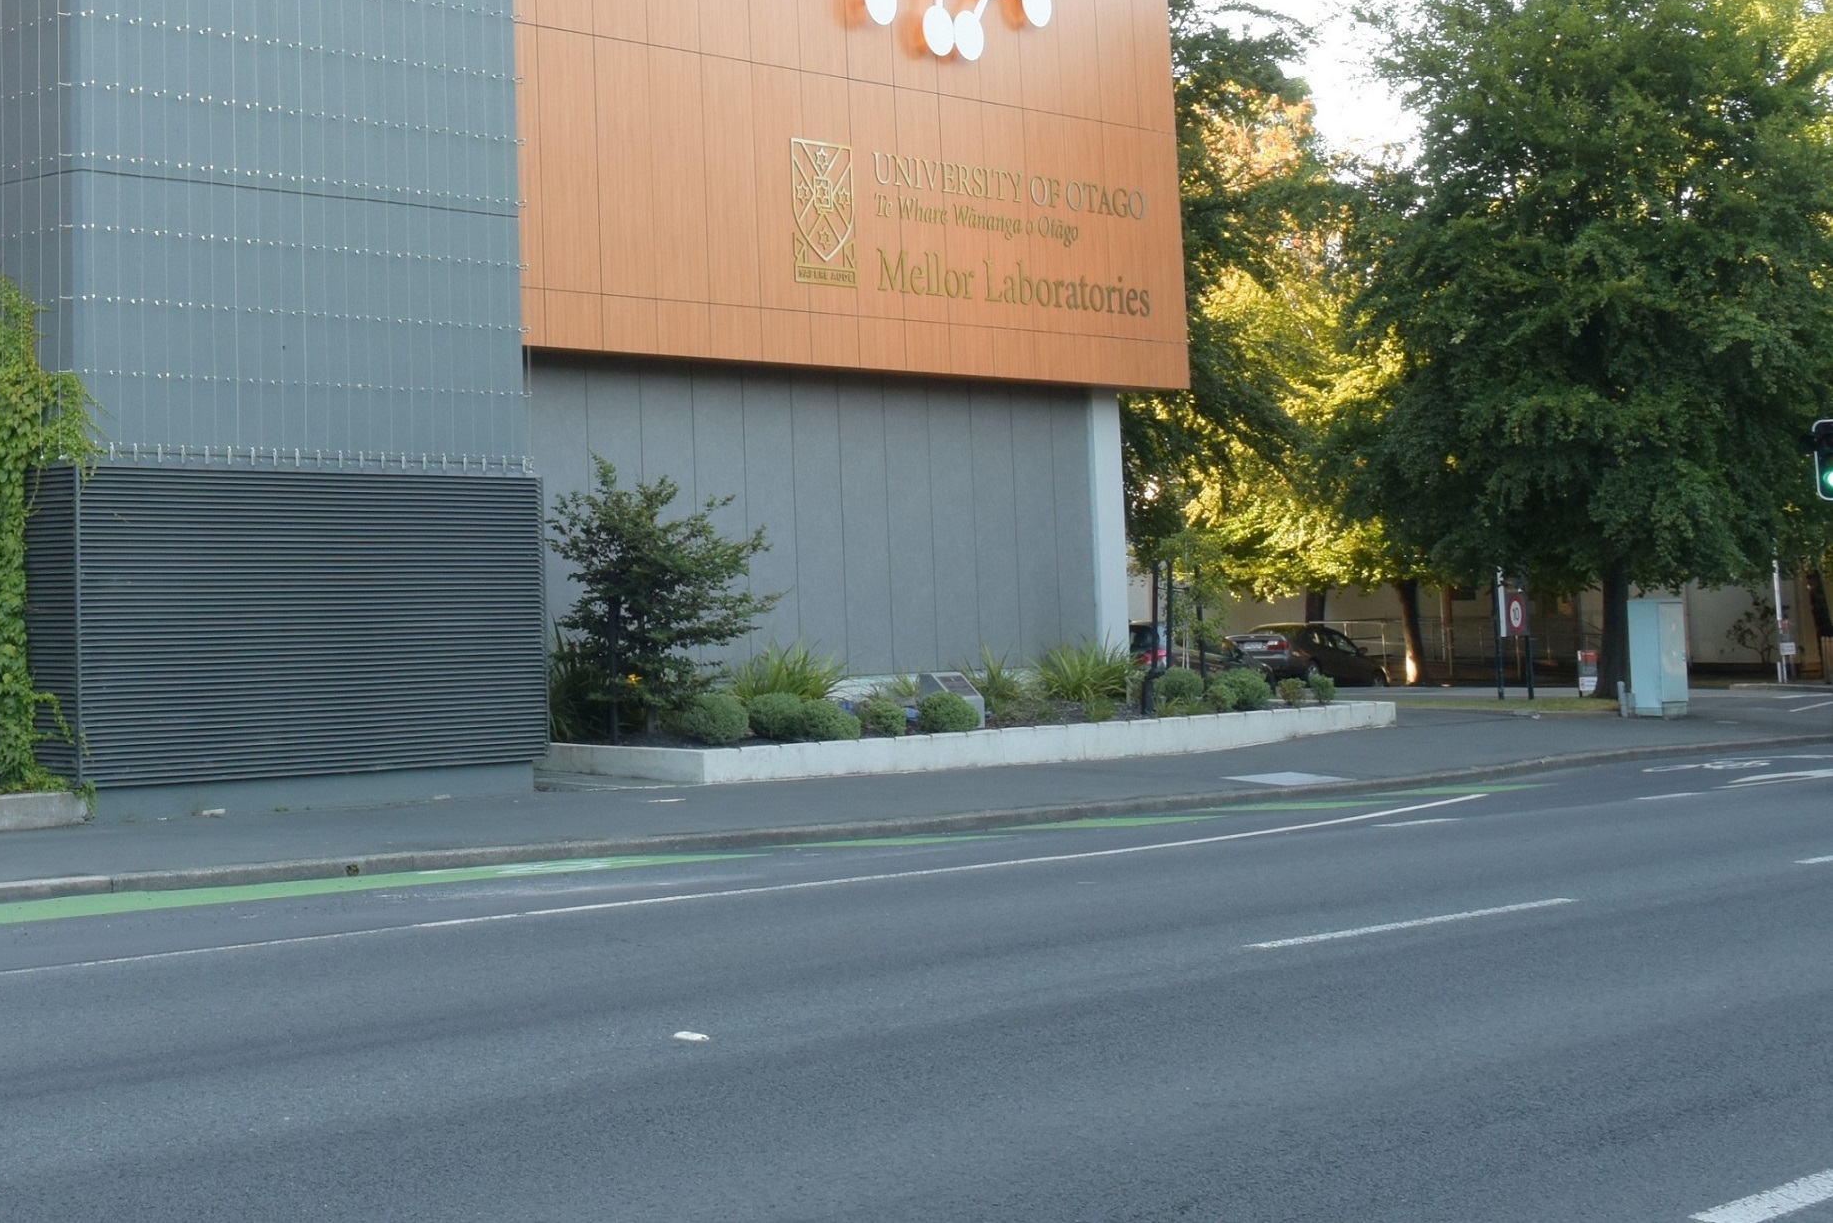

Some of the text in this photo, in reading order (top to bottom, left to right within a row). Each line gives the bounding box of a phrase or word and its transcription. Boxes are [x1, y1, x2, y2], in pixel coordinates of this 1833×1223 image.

[872, 151, 1145, 220] UNIVERSITY OF OTAGO
[874, 192, 893, 218] Te
[897, 196, 948, 226] Whare
[1026, 220, 1034, 236] o
[876, 247, 1151, 317] Mellor Laboratories
[1512, 607, 1520, 621] 10
